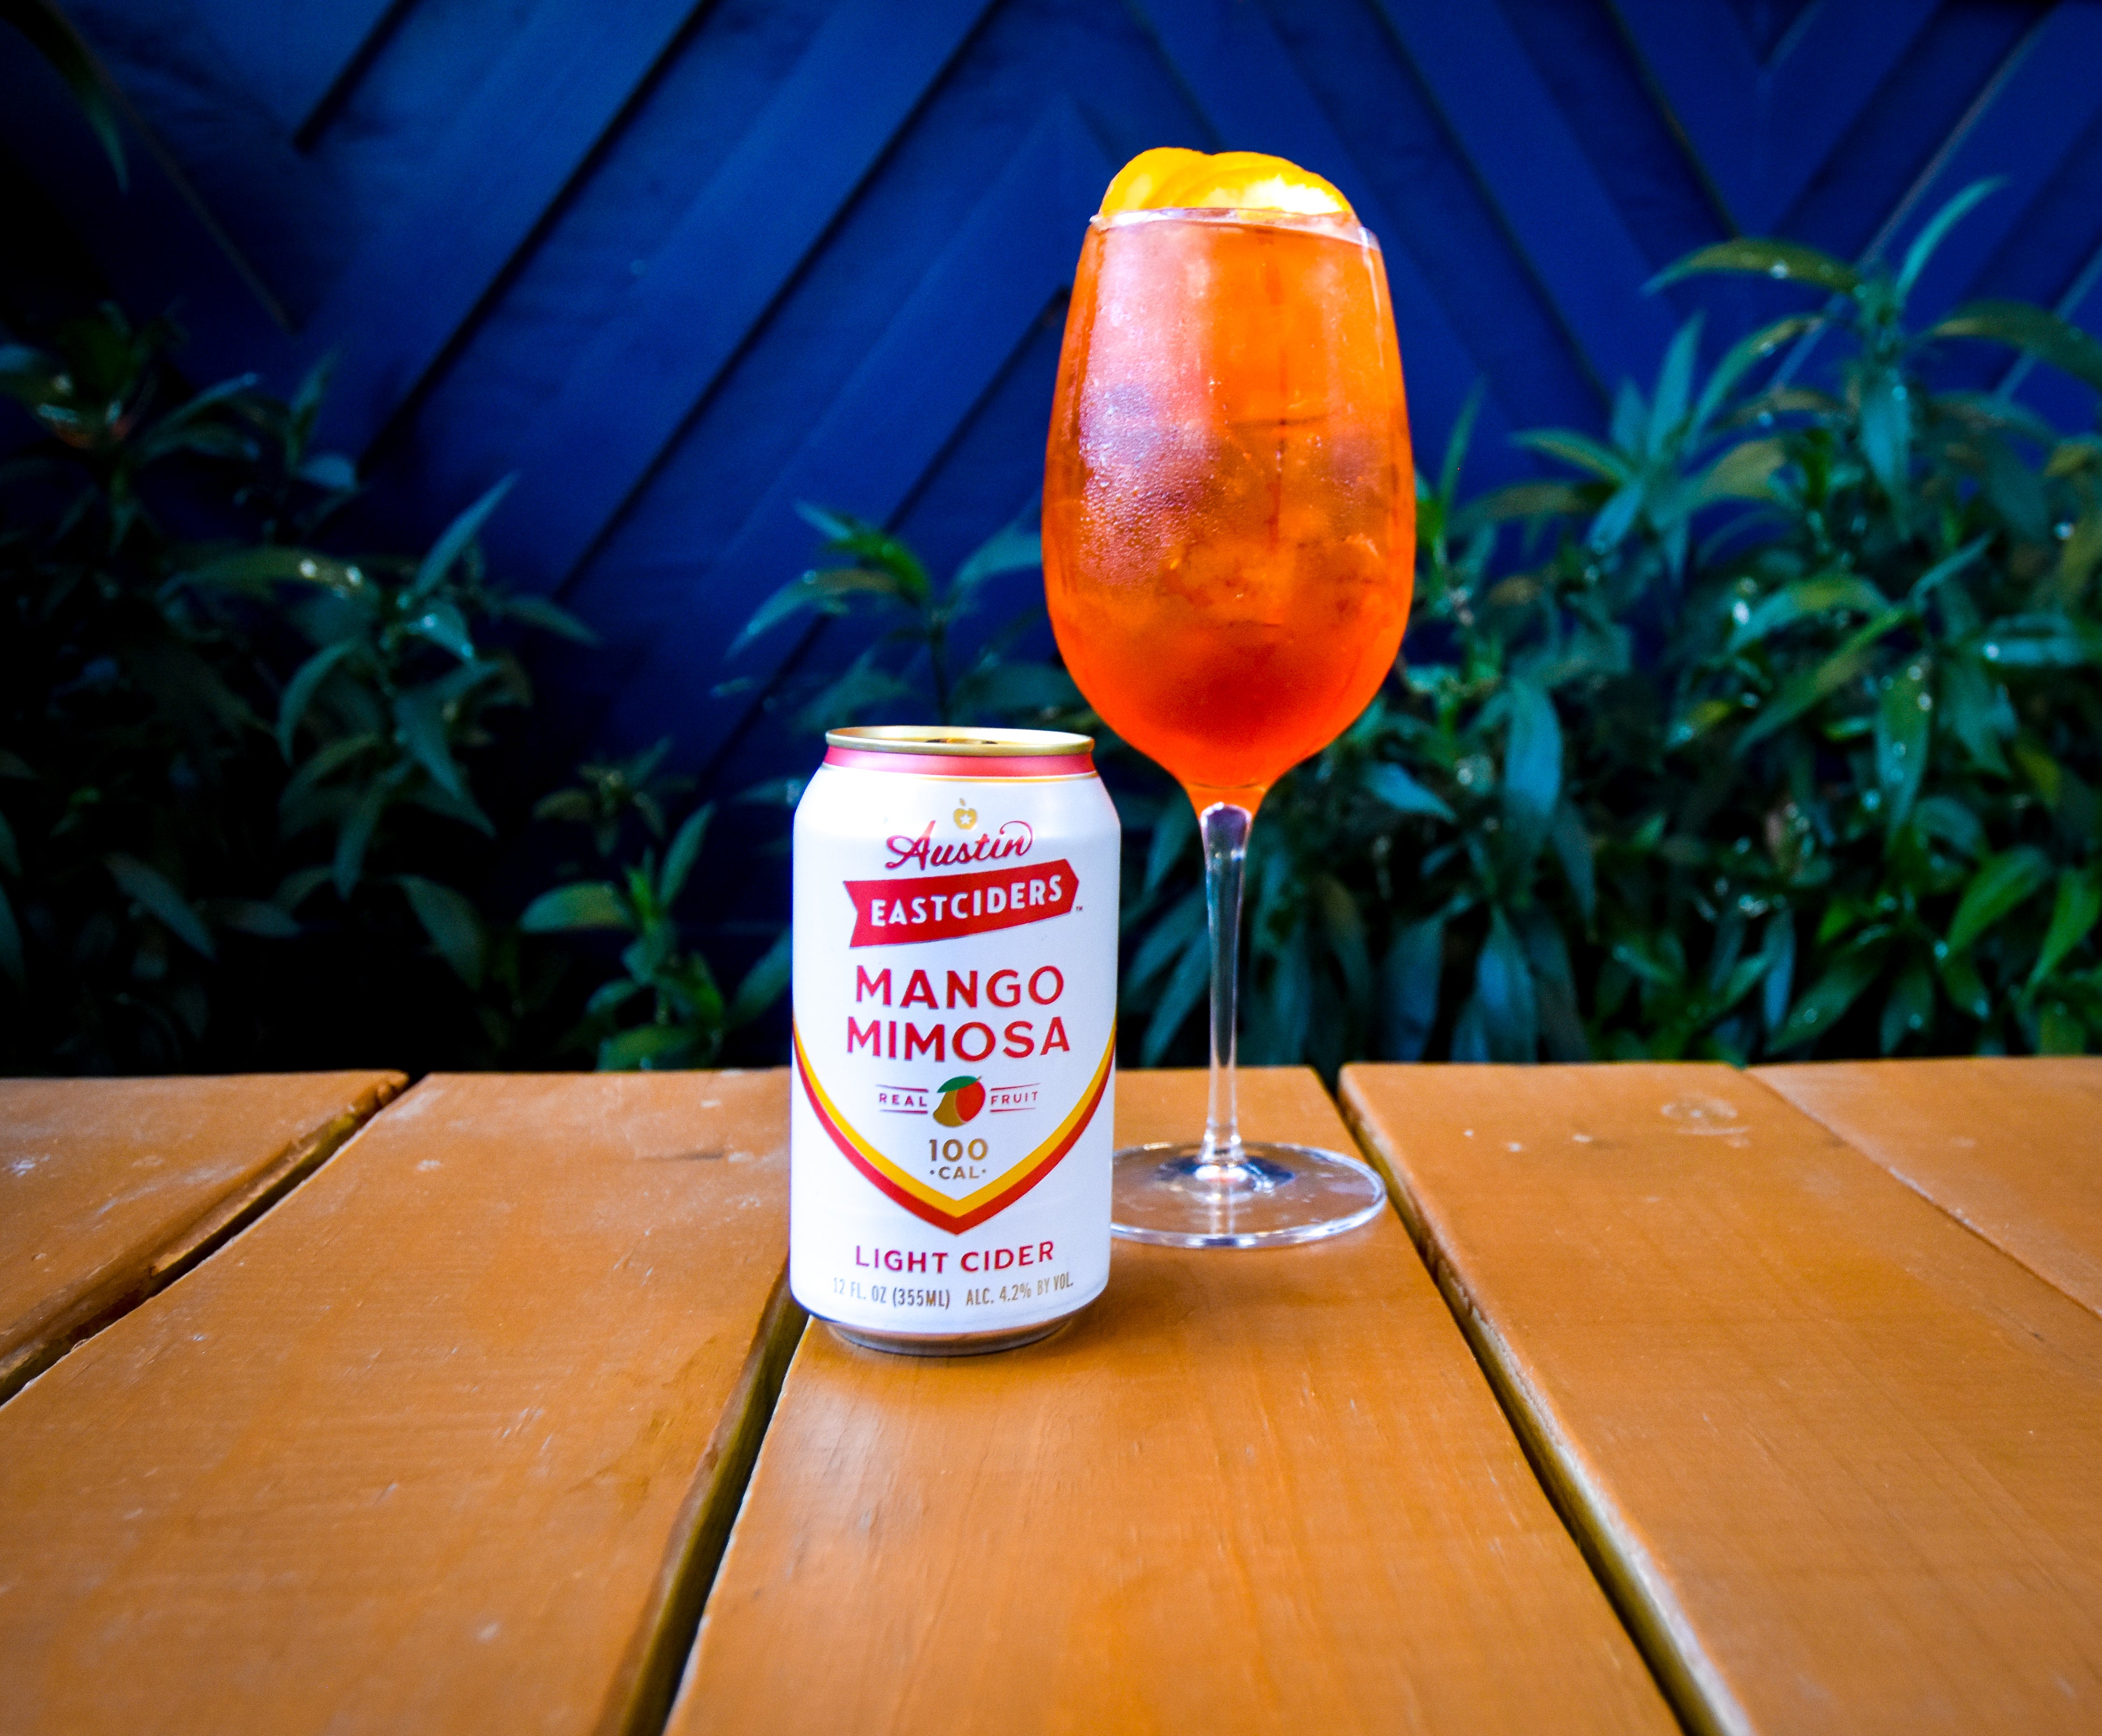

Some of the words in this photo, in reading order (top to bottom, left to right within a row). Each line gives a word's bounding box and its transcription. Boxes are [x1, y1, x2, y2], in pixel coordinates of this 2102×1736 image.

[885, 820, 1033, 871] Austin
[871, 875, 1062, 927] EASTCIDERS
[856, 965, 1064, 1009] MANGO
[847, 1016, 1070, 1062] MIMOSA
[879, 1093, 928, 1107] REAL
[990, 1091, 1038, 1105] FRUIT
[929, 1138, 988, 1162] 100
[855, 1245, 948, 1274] LIGHT
[961, 1241, 1054, 1272] CIDER
[833, 1277, 845, 1295] 12
[850, 1283, 866, 1300] FL.
[871, 1286, 887, 1304] OZ
[892, 1286, 951, 1310] (355ML)
[966, 1287, 995, 1306] ALC.
[999, 1280, 1031, 1303] 4.2%
[1037, 1277, 1050, 1295] BY
[1054, 1272, 1074, 1290] VOL.
